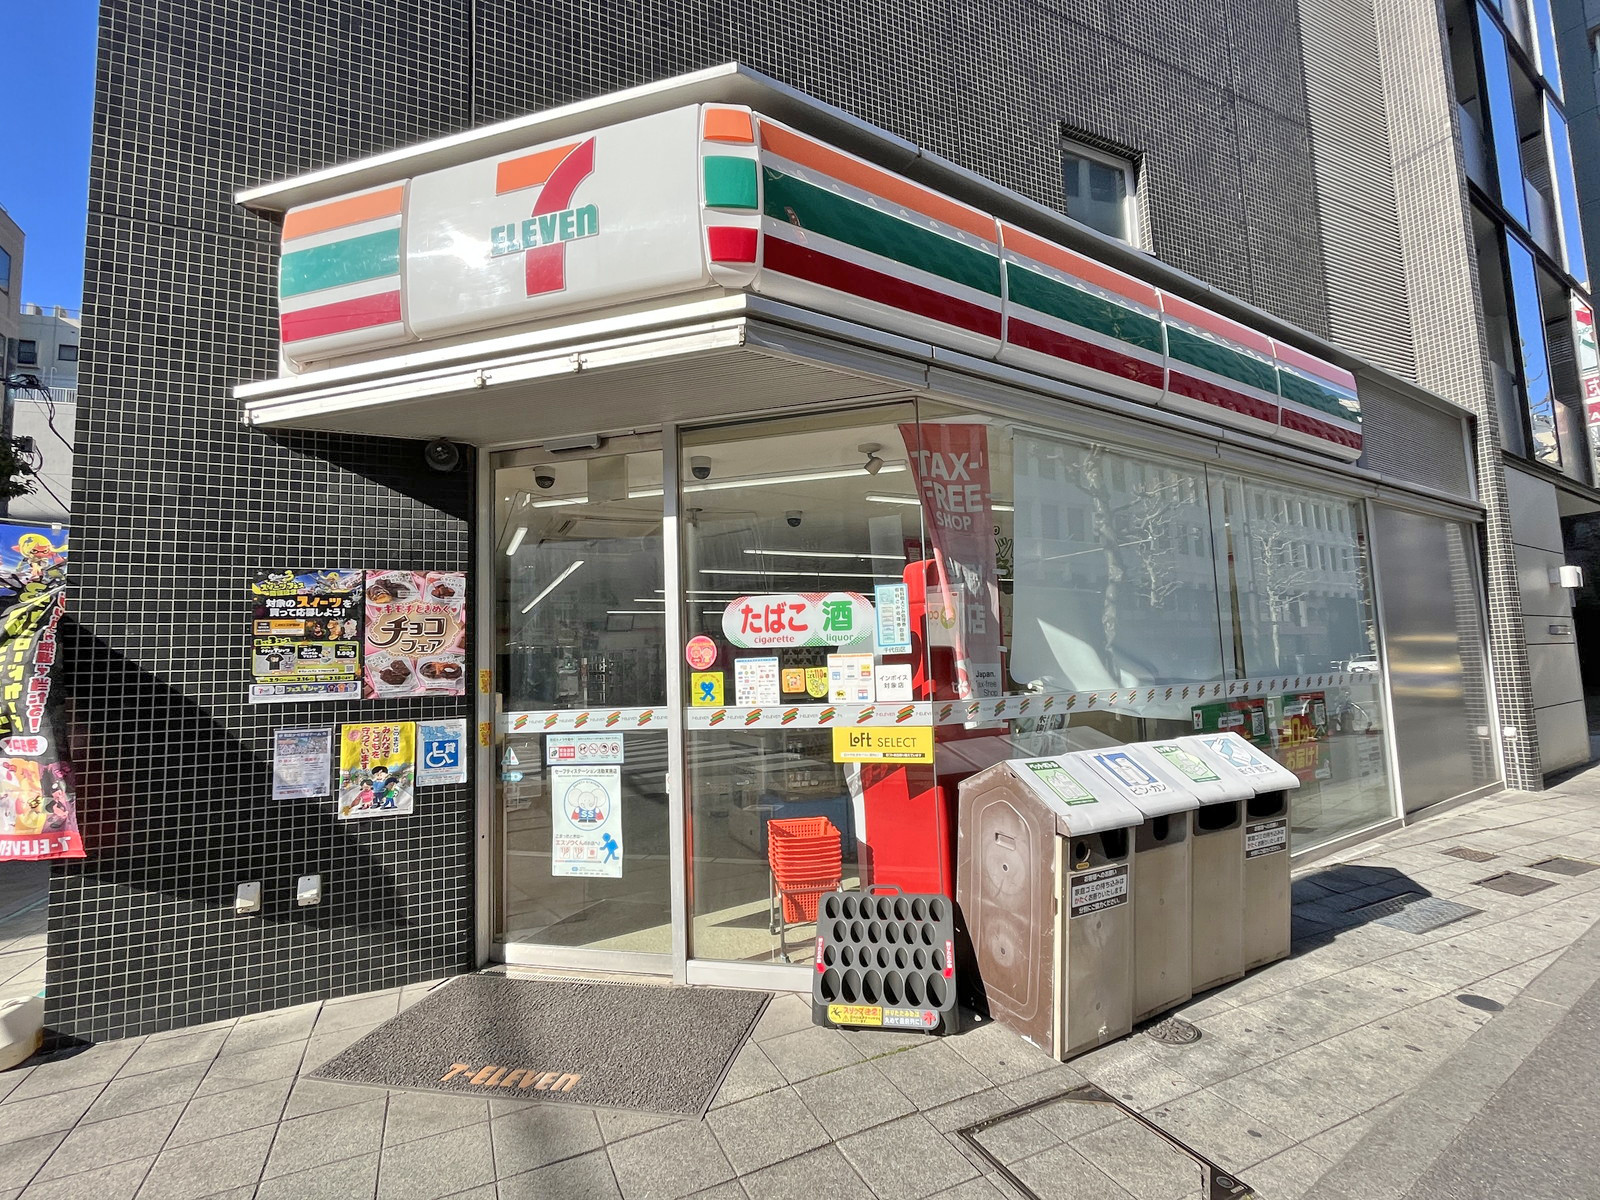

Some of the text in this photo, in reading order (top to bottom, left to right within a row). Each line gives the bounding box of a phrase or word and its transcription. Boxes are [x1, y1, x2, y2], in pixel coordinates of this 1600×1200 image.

[910, 450, 979, 481] TAX-
[936, 511, 971, 531] SHOP
[741, 600, 852, 634] たばこ 酒
[369, 616, 446, 647] チョコ
[754, 633, 854, 644] cigarette liquor
[400, 640, 444, 654] フェア
[371, 726, 380, 758] こどもを
[382, 726, 391, 758] みんなで
[877, 738, 916, 748] SELECT
[1074, 878, 1124, 896] 家庭ゴミの持ち込みは
